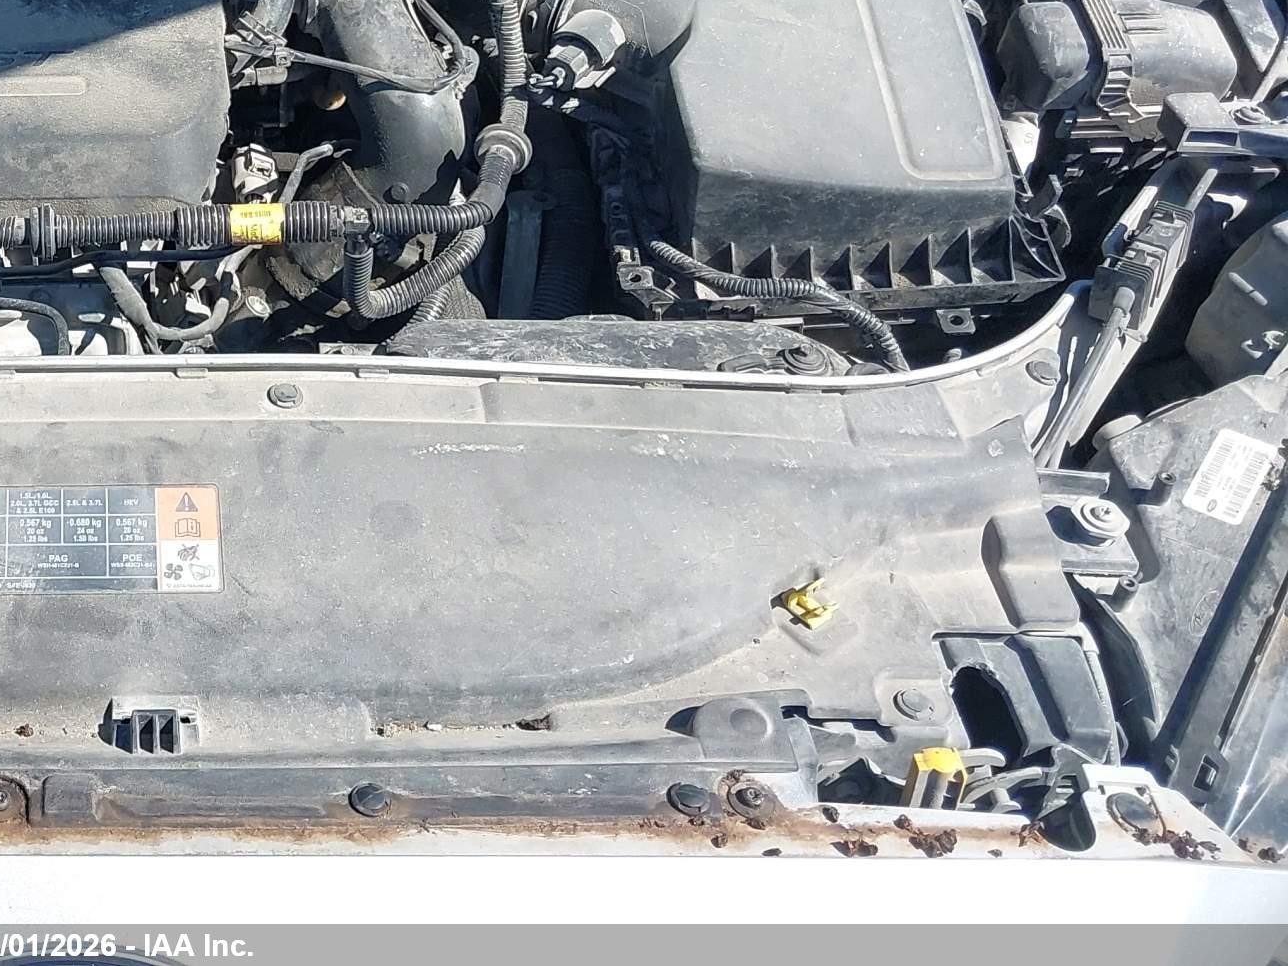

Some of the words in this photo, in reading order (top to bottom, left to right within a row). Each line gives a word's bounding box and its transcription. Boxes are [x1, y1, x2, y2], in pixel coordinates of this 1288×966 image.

[20, 519, 40, 527] 0.567
[42, 519, 52, 528] kg
[92, 518, 102, 527] kg
[115, 518, 136, 526] 0.567
[138, 518, 147, 527] kg
[48, 554, 69, 562] PAG
[122, 554, 143, 562] POE
